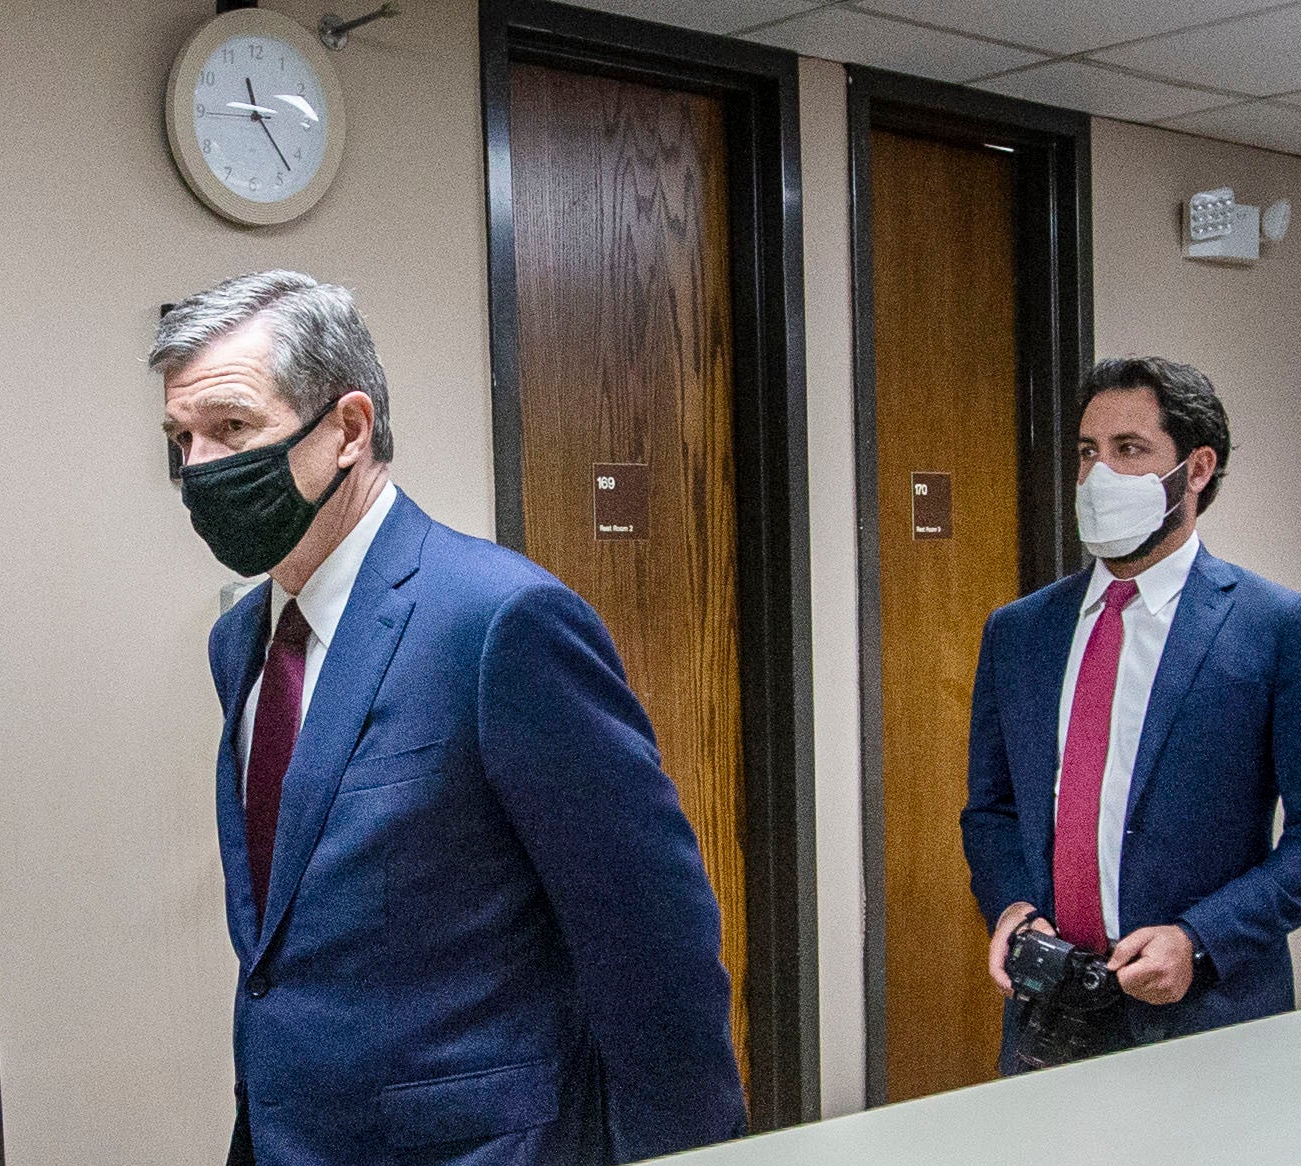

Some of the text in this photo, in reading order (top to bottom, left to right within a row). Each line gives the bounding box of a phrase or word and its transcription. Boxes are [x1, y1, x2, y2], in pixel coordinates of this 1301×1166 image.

[221, 49, 235, 65] 11
[248, 44, 264, 60] 12
[199, 70, 215, 86] 10
[296, 82, 305, 97] 2
[197, 103, 206, 118] 9
[202, 138, 212, 154] 8
[293, 147, 302, 160] 4
[224, 166, 233, 180] 7
[276, 171, 284, 186] 5
[248, 177, 257, 191] 6
[597, 476, 615, 489] 169
[914, 483, 928, 496] 170
